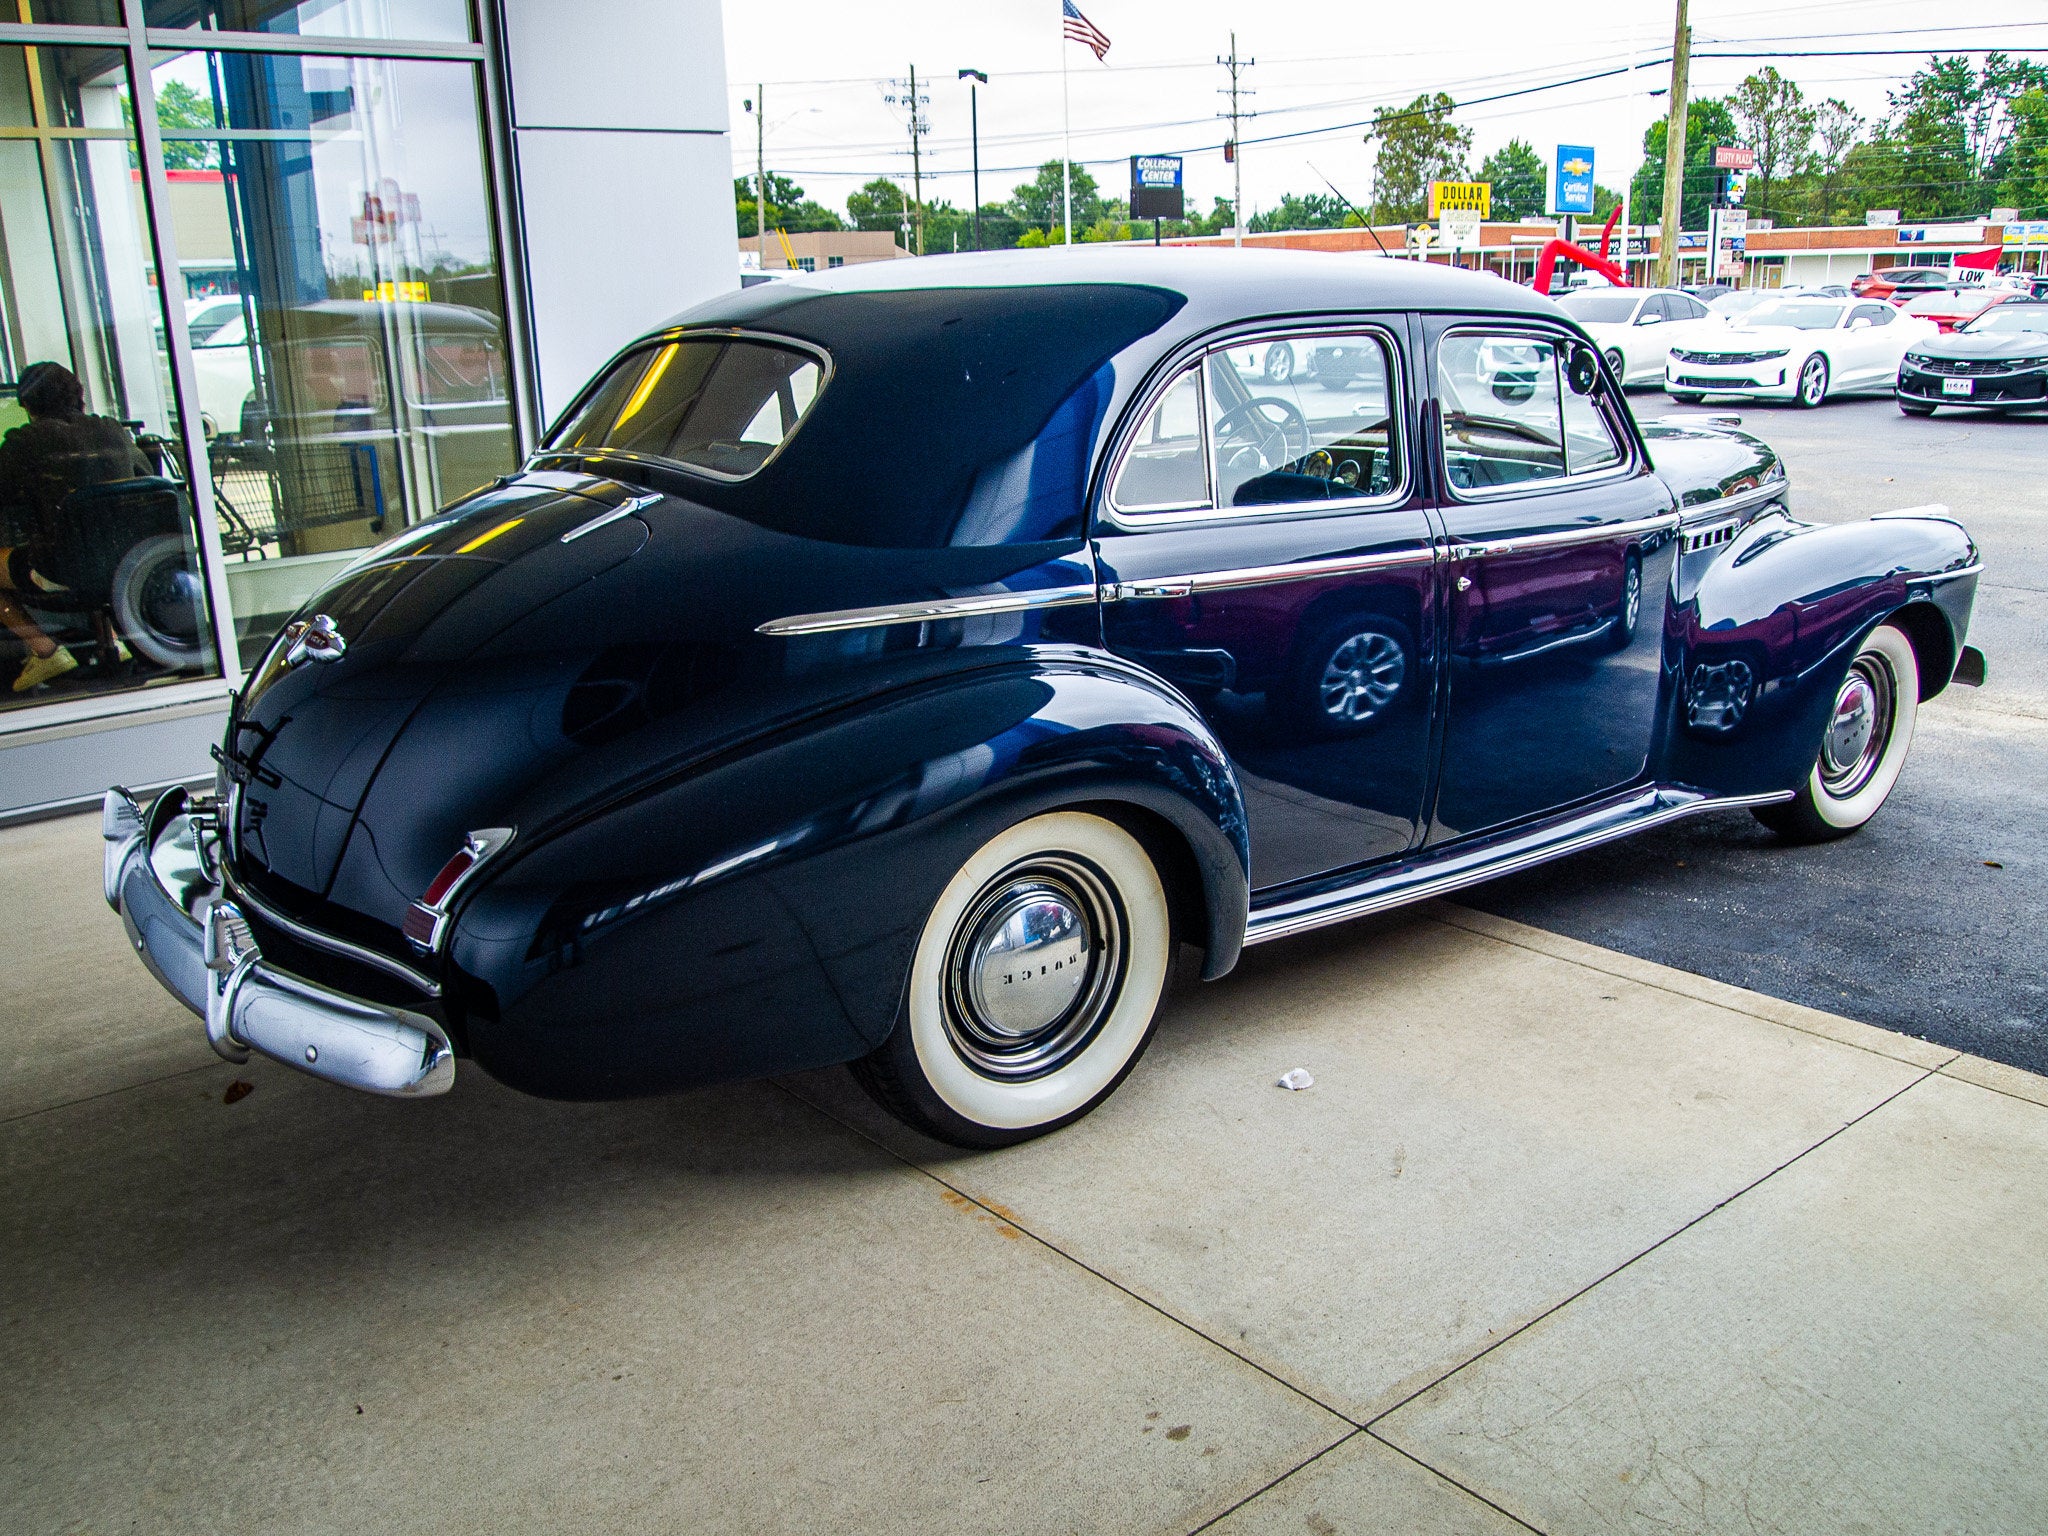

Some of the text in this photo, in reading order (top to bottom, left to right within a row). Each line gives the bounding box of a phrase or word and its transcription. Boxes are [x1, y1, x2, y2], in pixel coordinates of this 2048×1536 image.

[1137, 157, 1180, 171] COLLISION
[1141, 169, 1175, 183] CENTER
[1443, 186, 1482, 200] DOLLAR
[1959, 270, 1985, 283] LOW
